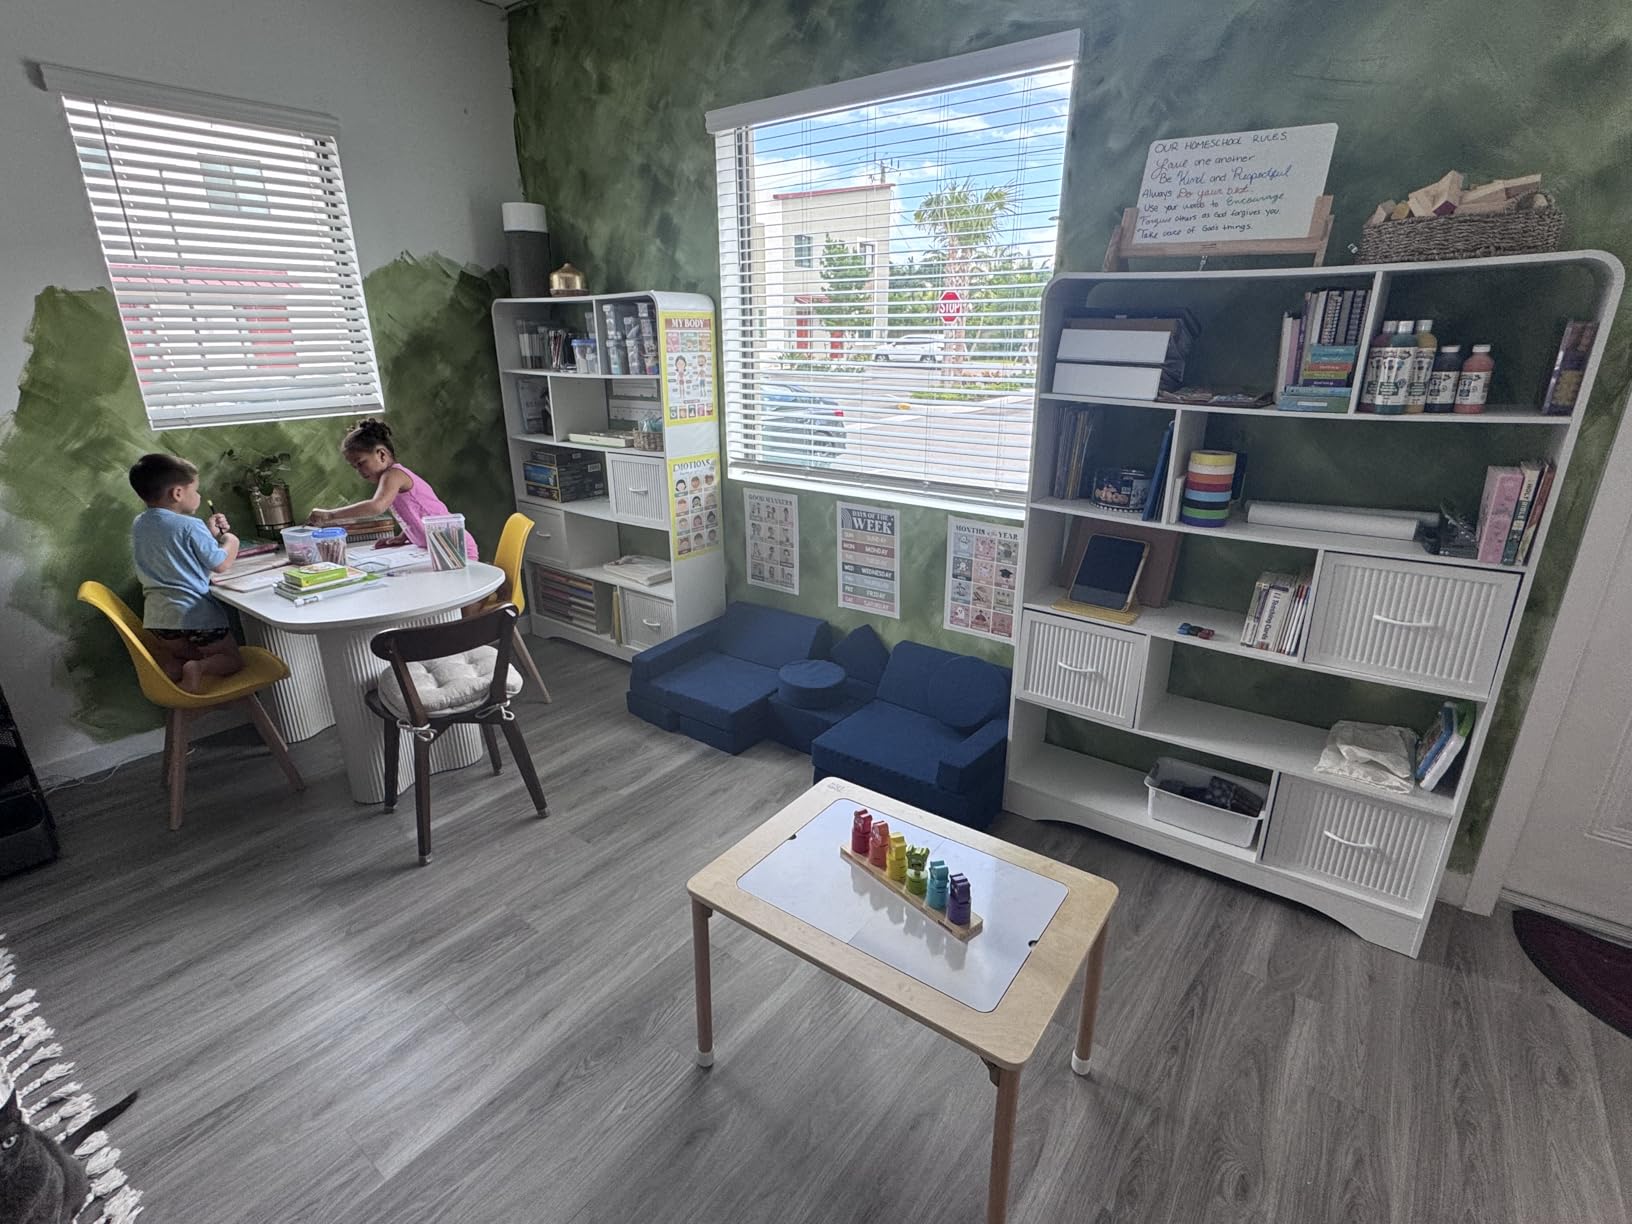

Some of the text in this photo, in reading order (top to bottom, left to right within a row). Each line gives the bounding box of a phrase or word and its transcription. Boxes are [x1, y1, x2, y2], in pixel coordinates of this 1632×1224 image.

[1154, 131, 1288, 154] OUR HOMESCHOOL RULES
[1194, 158, 1212, 167] one
[1214, 154, 1256, 164] another
[1158, 172, 1173, 184] Be
[1176, 170, 1206, 186] Kind
[1209, 173, 1227, 182] and
[1142, 188, 1172, 200] Always
[1176, 187, 1193, 199] Do
[1143, 203, 1159, 213] Use
[1164, 203, 1178, 214] your
[1210, 200, 1219, 208] to
[1226, 193, 1285, 207] Encourage
[1139, 215, 1172, 228] Forgive
[1174, 214, 1198, 222] others
[1213, 210, 1227, 218] God
[1230, 208, 1261, 218] forgives
[1136, 228, 1159, 239] Take
[1186, 226, 1196, 234] of
[940, 302, 961, 313] STOP
[671, 318, 705, 328] MY BODY
[673, 459, 711, 472] EMOTIONS
[1523, 483, 1534, 500] HOLY
[877, 513, 888, 521] THE
[852, 517, 892, 535] WEEK
[956, 525, 985, 534] MONTHS
[998, 531, 1018, 540] YEAR
[865, 546, 888, 556] MONDAY
